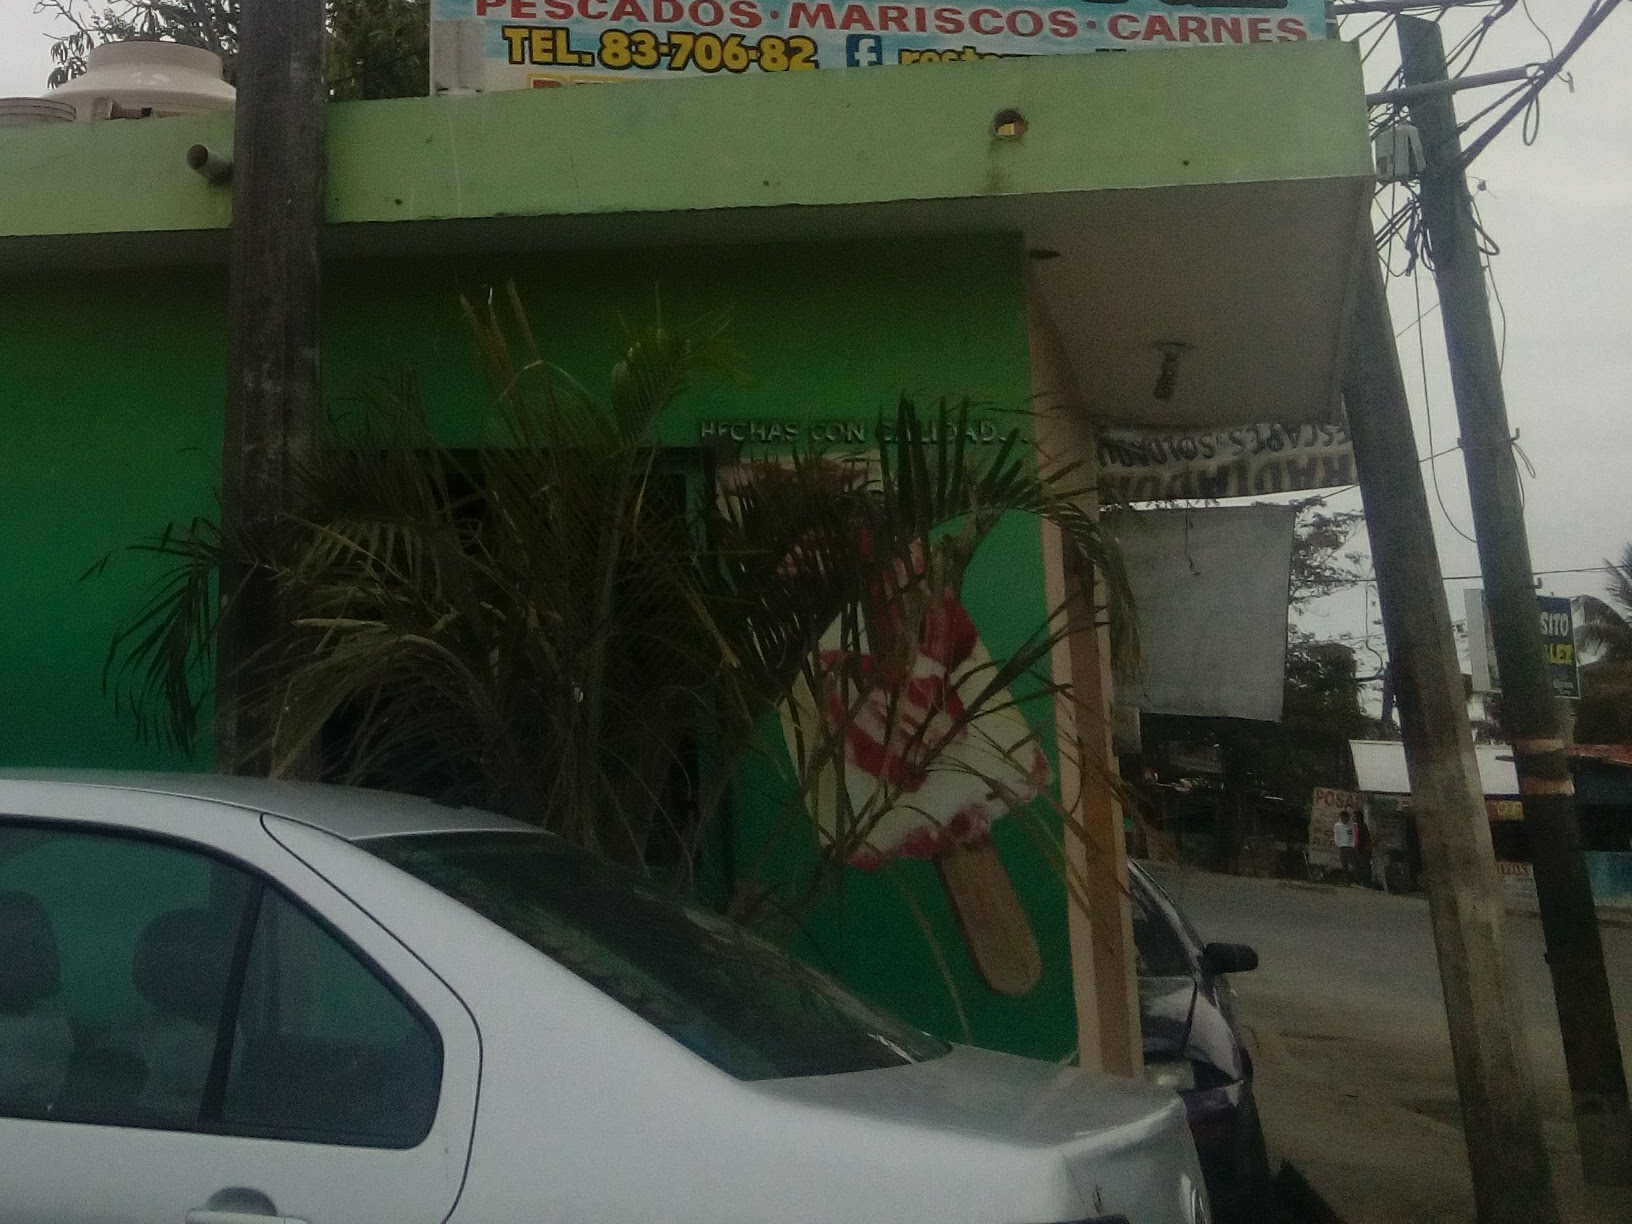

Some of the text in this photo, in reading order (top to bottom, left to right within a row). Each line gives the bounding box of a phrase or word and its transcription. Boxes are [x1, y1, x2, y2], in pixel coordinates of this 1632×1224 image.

[789, 0, 1080, 39] MARISCOS
[1106, 12, 1309, 44] CARNES
[502, 25, 595, 66] TEL.
[599, 29, 820, 73] 83-706-82
[811, 421, 866, 444] CON
[1540, 611, 1570, 637] SITO
